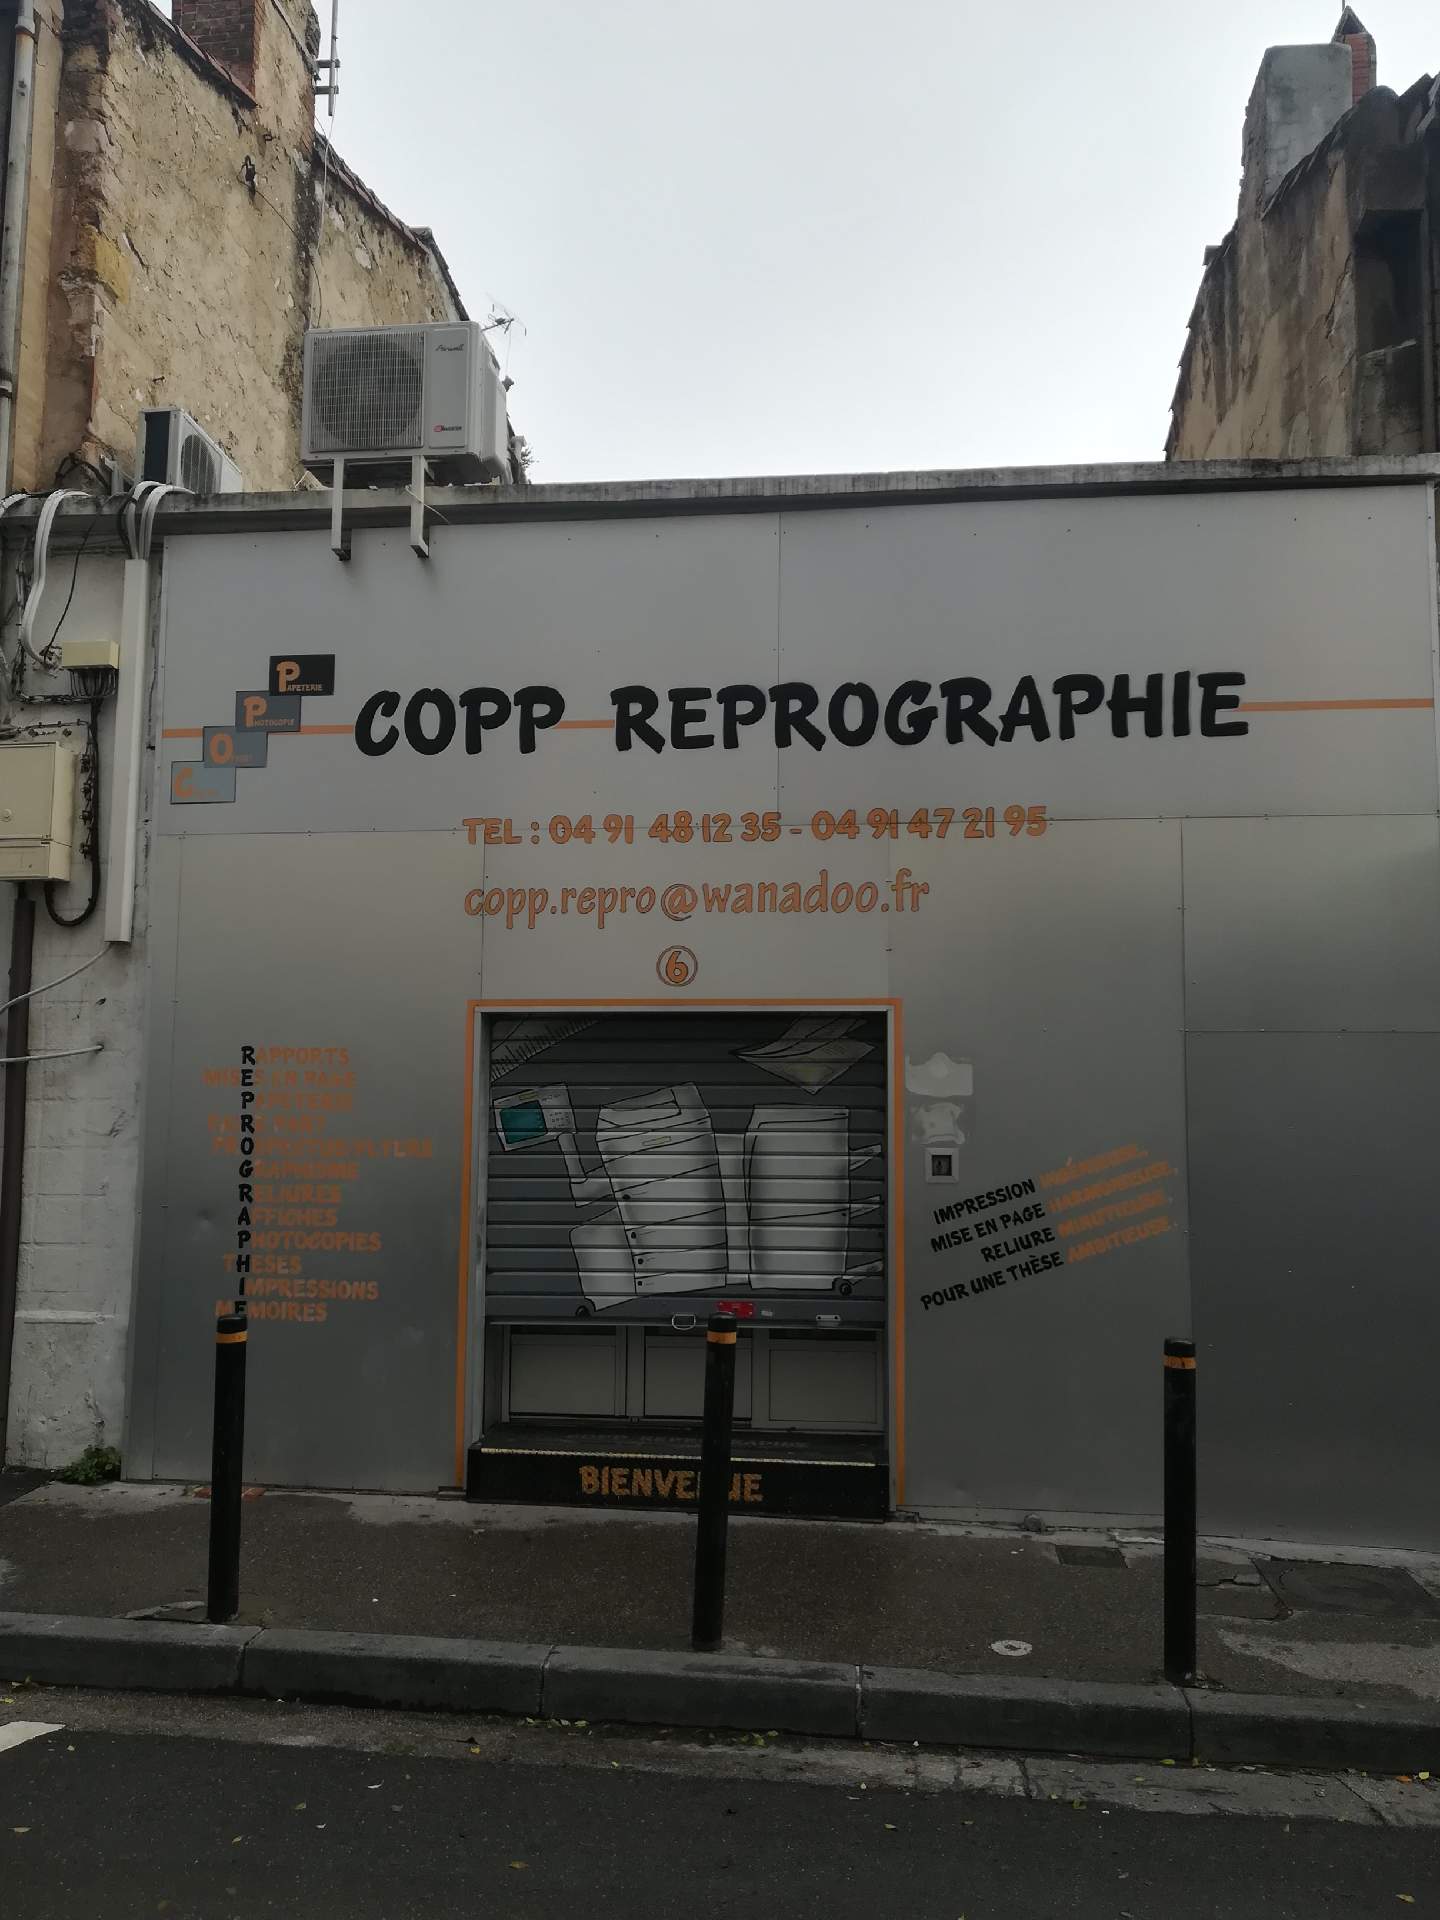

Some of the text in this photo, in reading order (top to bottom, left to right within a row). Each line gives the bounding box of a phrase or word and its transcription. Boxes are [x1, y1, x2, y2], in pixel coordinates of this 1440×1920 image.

[355, 669, 1249, 756] COPP REPROGRAPHIE
[548, 814, 596, 845] 04
[602, 814, 633, 844] 91
[647, 810, 694, 844] 48
[701, 812, 732, 844] 12
[740, 811, 782, 843] 35
[811, 809, 860, 841] 04
[866, 808, 898, 840] 91
[906, 808, 955, 840] 47
[962, 807, 995, 839] 21
[1004, 804, 1048, 837] 95
[462, 867, 930, 931] copp.repro@wanadoo.fr
[933, 1179, 1036, 1225] IMPRESSION
[930, 1203, 1047, 1253] MISE EN PAGE
[980, 1227, 1056, 1263] RELIURE
[920, 1282, 969, 1311] POUR
[971, 1270, 1007, 1295] UNE
[1006, 1250, 1065, 1283] THÈSE
